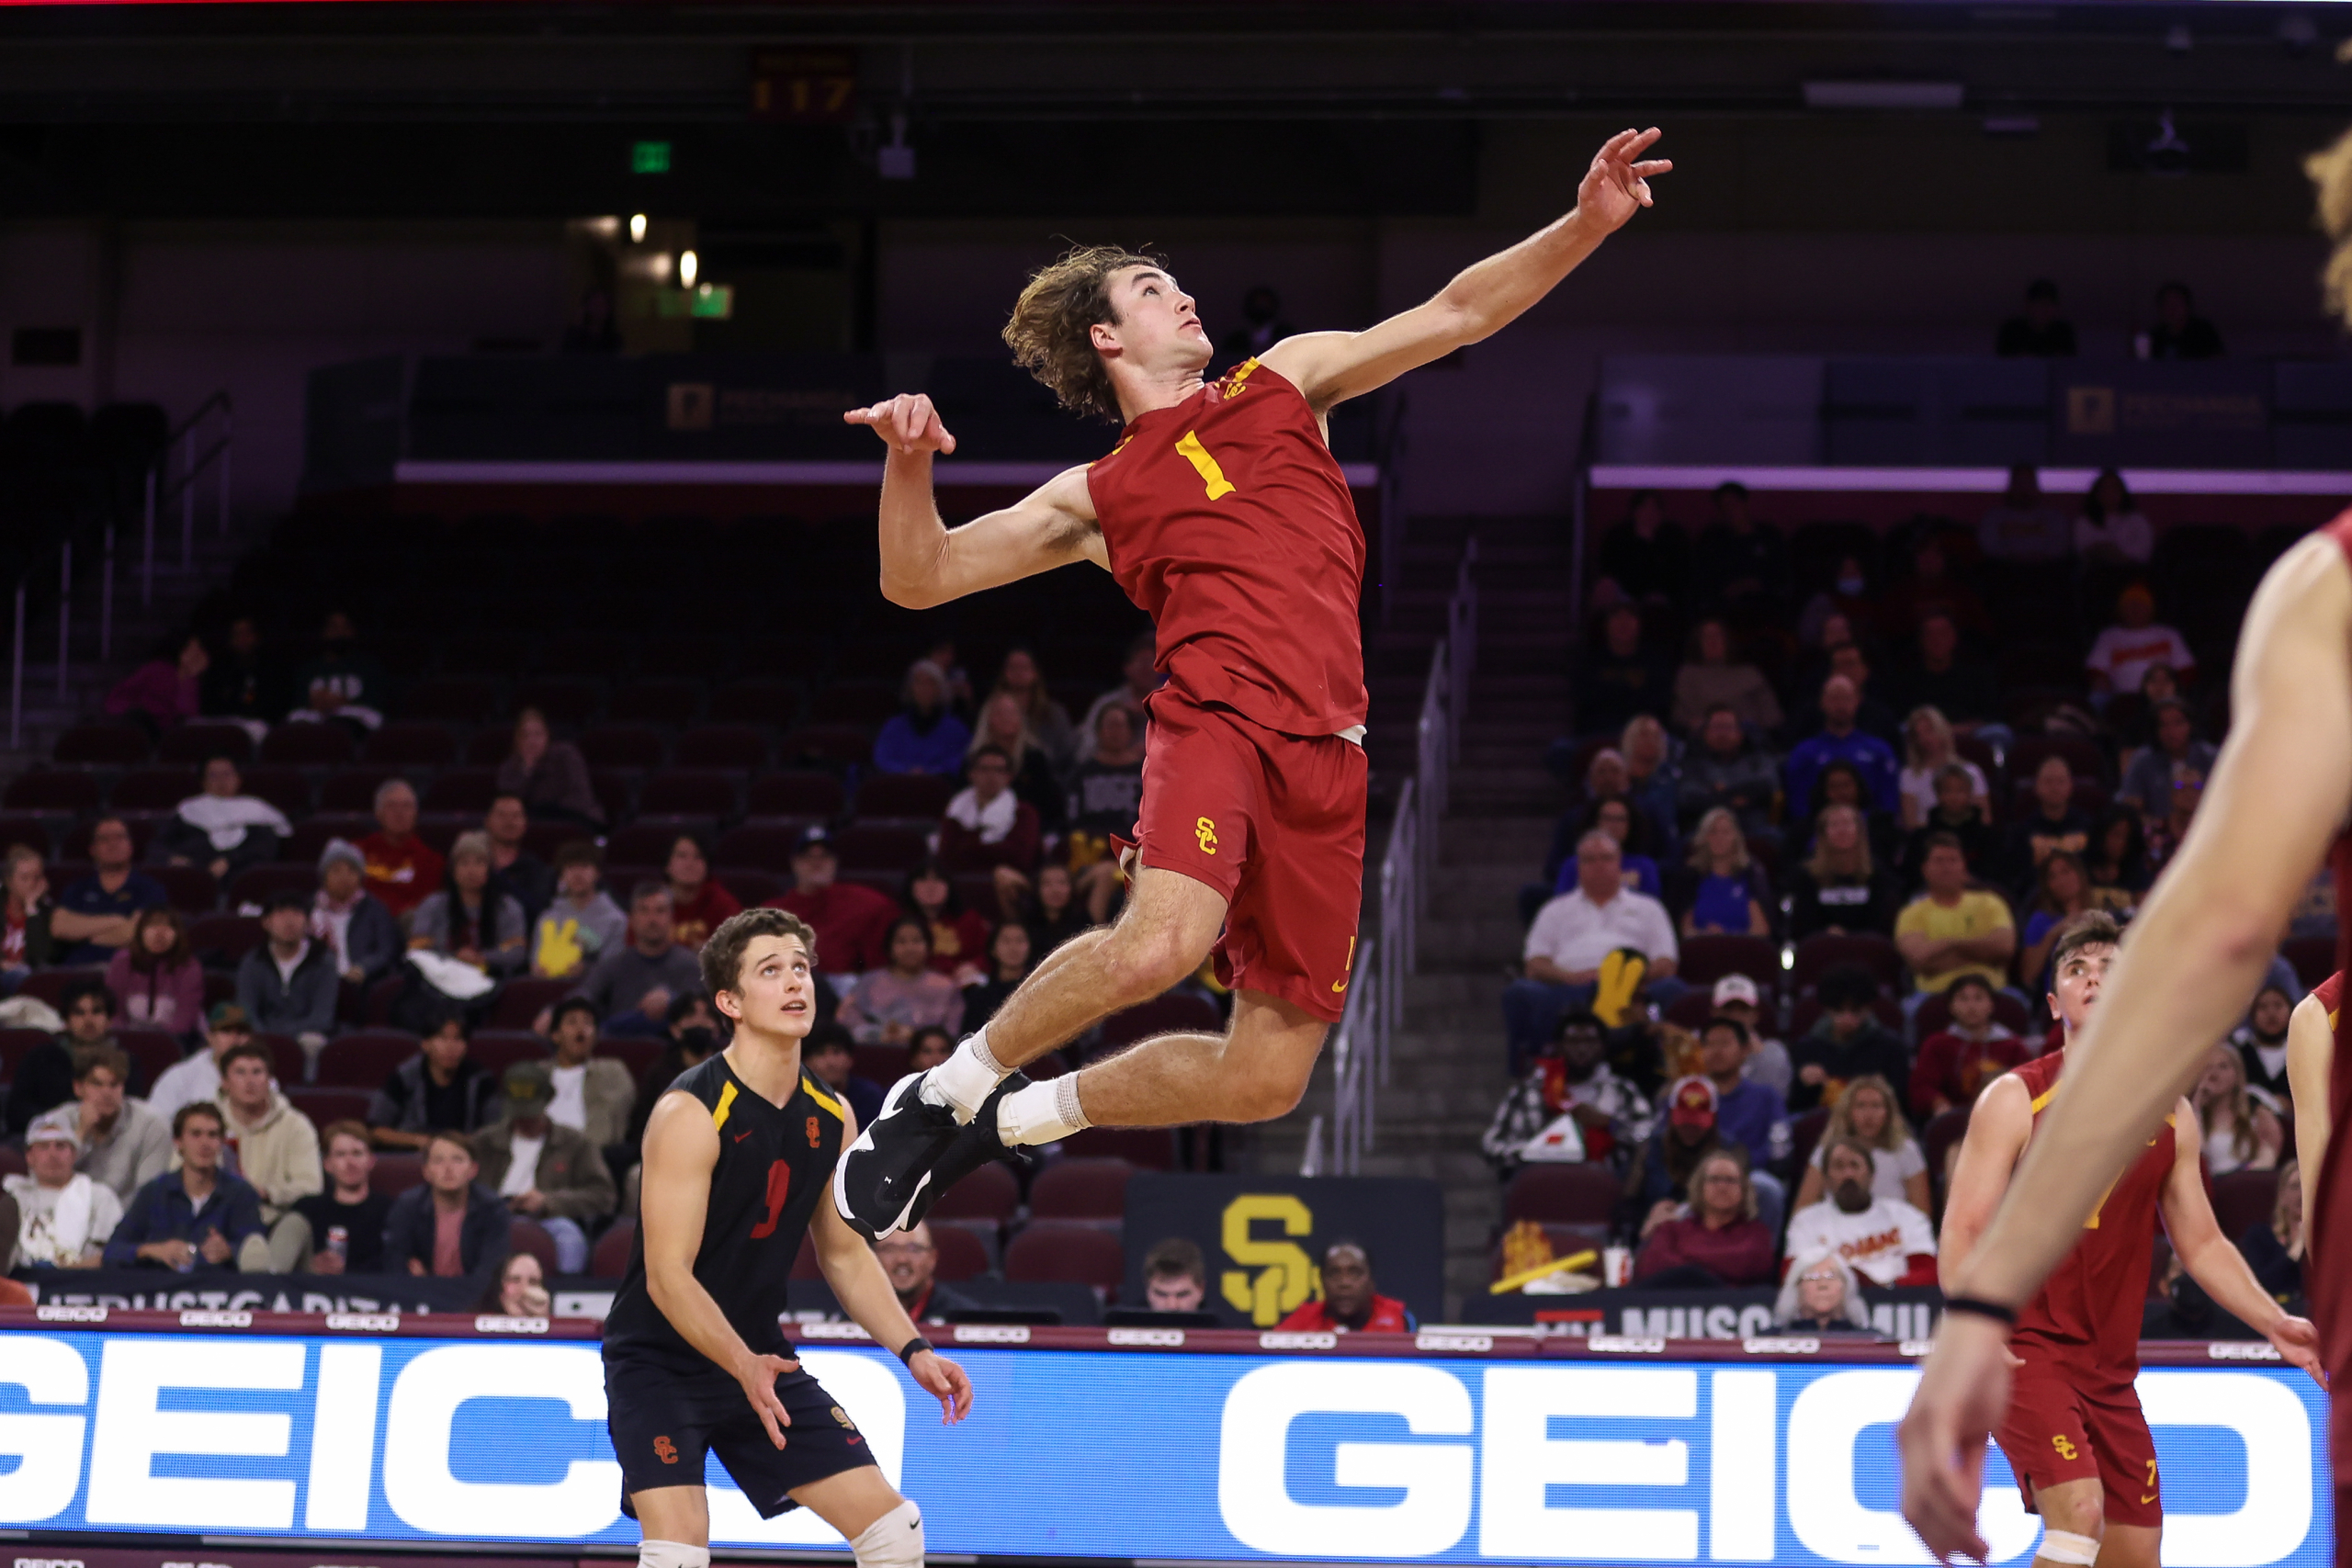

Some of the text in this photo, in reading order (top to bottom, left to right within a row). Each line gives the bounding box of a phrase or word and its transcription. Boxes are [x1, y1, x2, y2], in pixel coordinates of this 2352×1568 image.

[753, 77, 855, 112] 117
[1175, 430, 1237, 501] 1
[1195, 817, 1218, 855] SC
[36, 1304, 108, 1322] GEICO
[179, 1311, 253, 1327] GEICO
[325, 1314, 400, 1330] GEICO
[1621, 1303, 1771, 1340] MUSC
[474, 1314, 549, 1333] GEICO
[954, 1325, 1031, 1342] GEICO
[1107, 1328, 1184, 1345] GEICO
[1260, 1332, 1337, 1348] GEICO
[1415, 1336, 1493, 1351] GEICO
[1589, 1336, 1666, 1353] GEICO
[1743, 1337, 1820, 1353] GEICO
[653, 1436, 678, 1464] SC
[2052, 1435, 2078, 1461] SC
[1218, 1360, 2312, 1567] GEICO
[2146, 1459, 2156, 1487] 7
